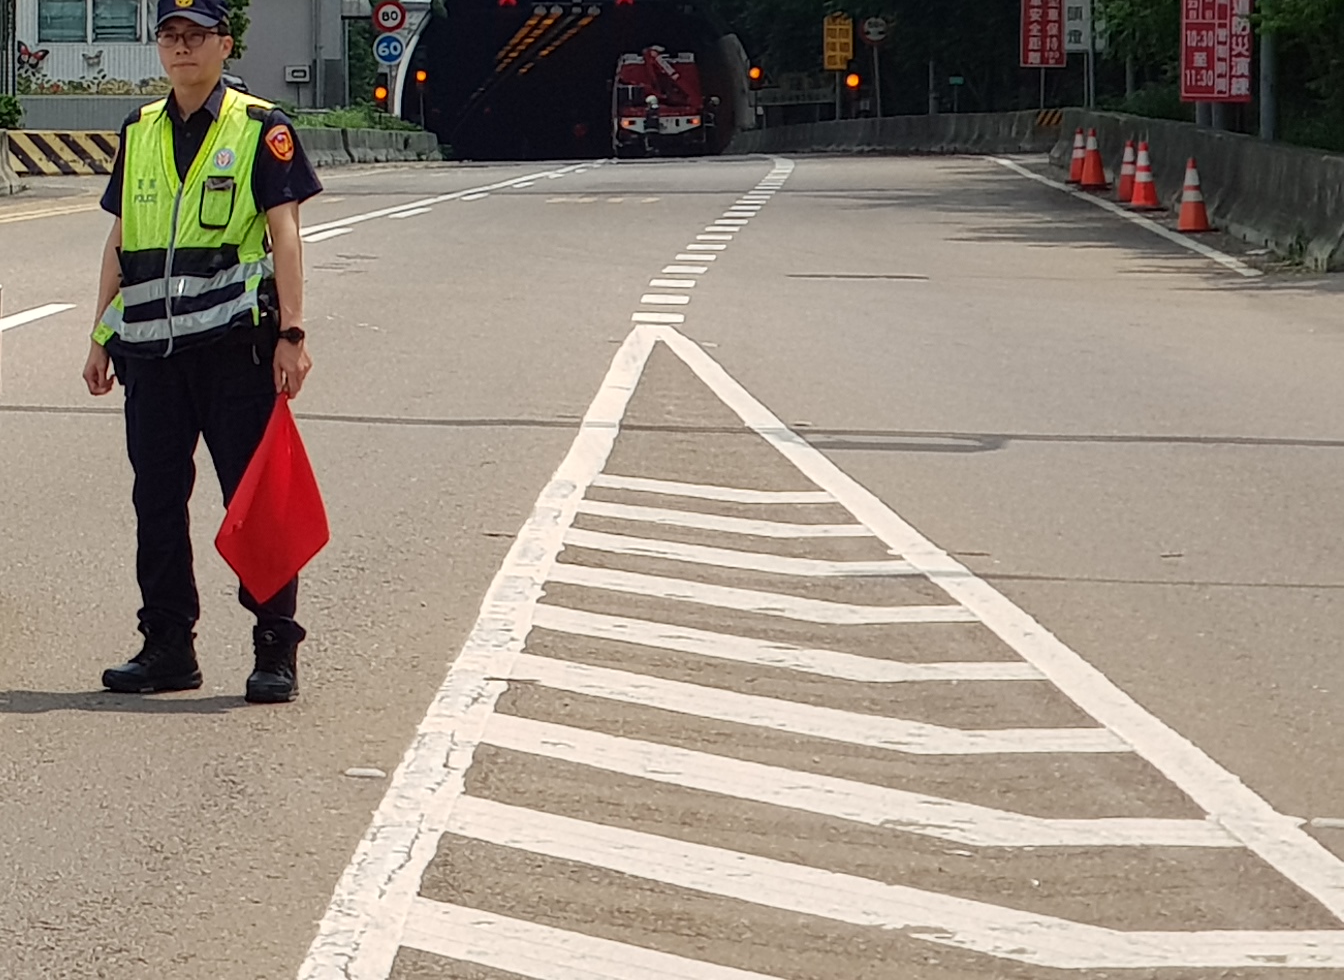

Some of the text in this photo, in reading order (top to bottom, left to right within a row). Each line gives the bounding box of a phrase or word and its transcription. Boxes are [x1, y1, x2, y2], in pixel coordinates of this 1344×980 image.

[381, 10, 399, 22] 80
[1186, 30, 1214, 47] 10:30
[378, 41, 402, 56] 60
[1185, 69, 1214, 87] 11:30
